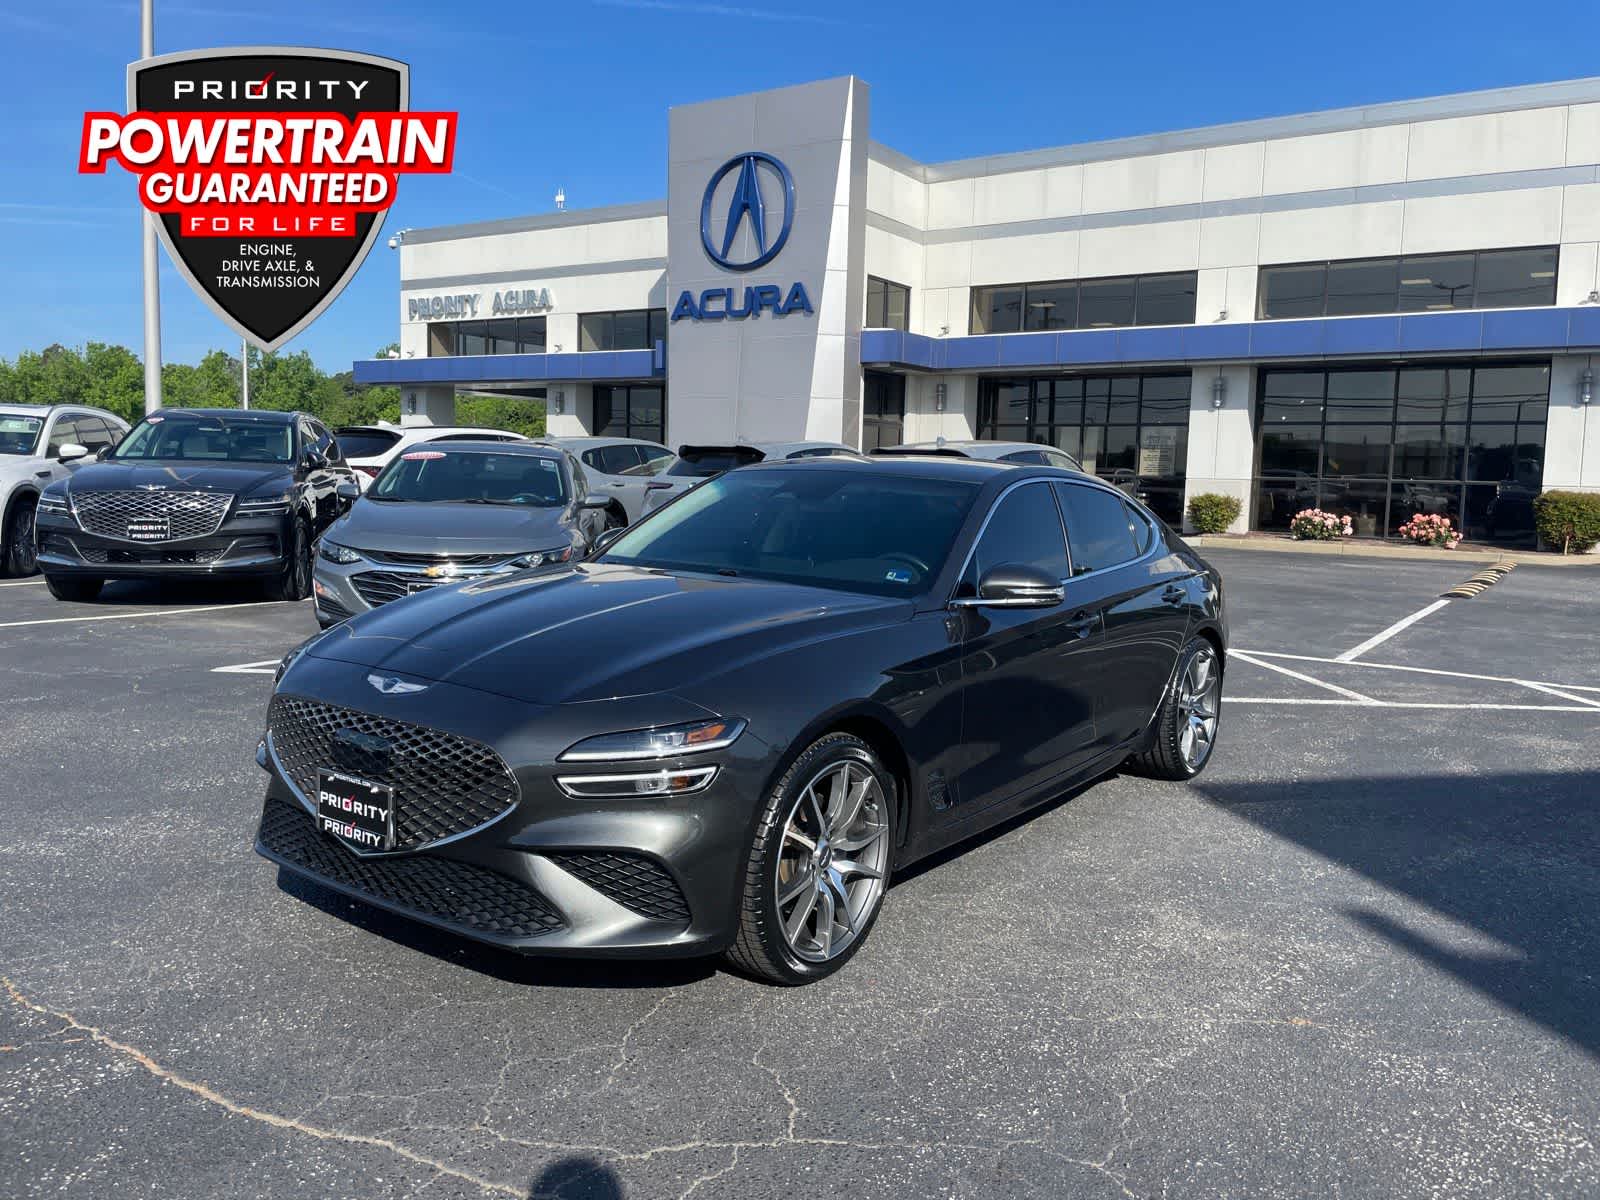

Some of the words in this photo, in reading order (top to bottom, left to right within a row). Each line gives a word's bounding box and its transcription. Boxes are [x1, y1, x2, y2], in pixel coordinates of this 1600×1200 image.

[408, 293, 480, 319] PRIORITY
[492, 287, 552, 315] ACURA
[670, 281, 815, 322] ACURA
[320, 791, 388, 822] PRIORITY
[324, 819, 381, 847] PRIORITY
